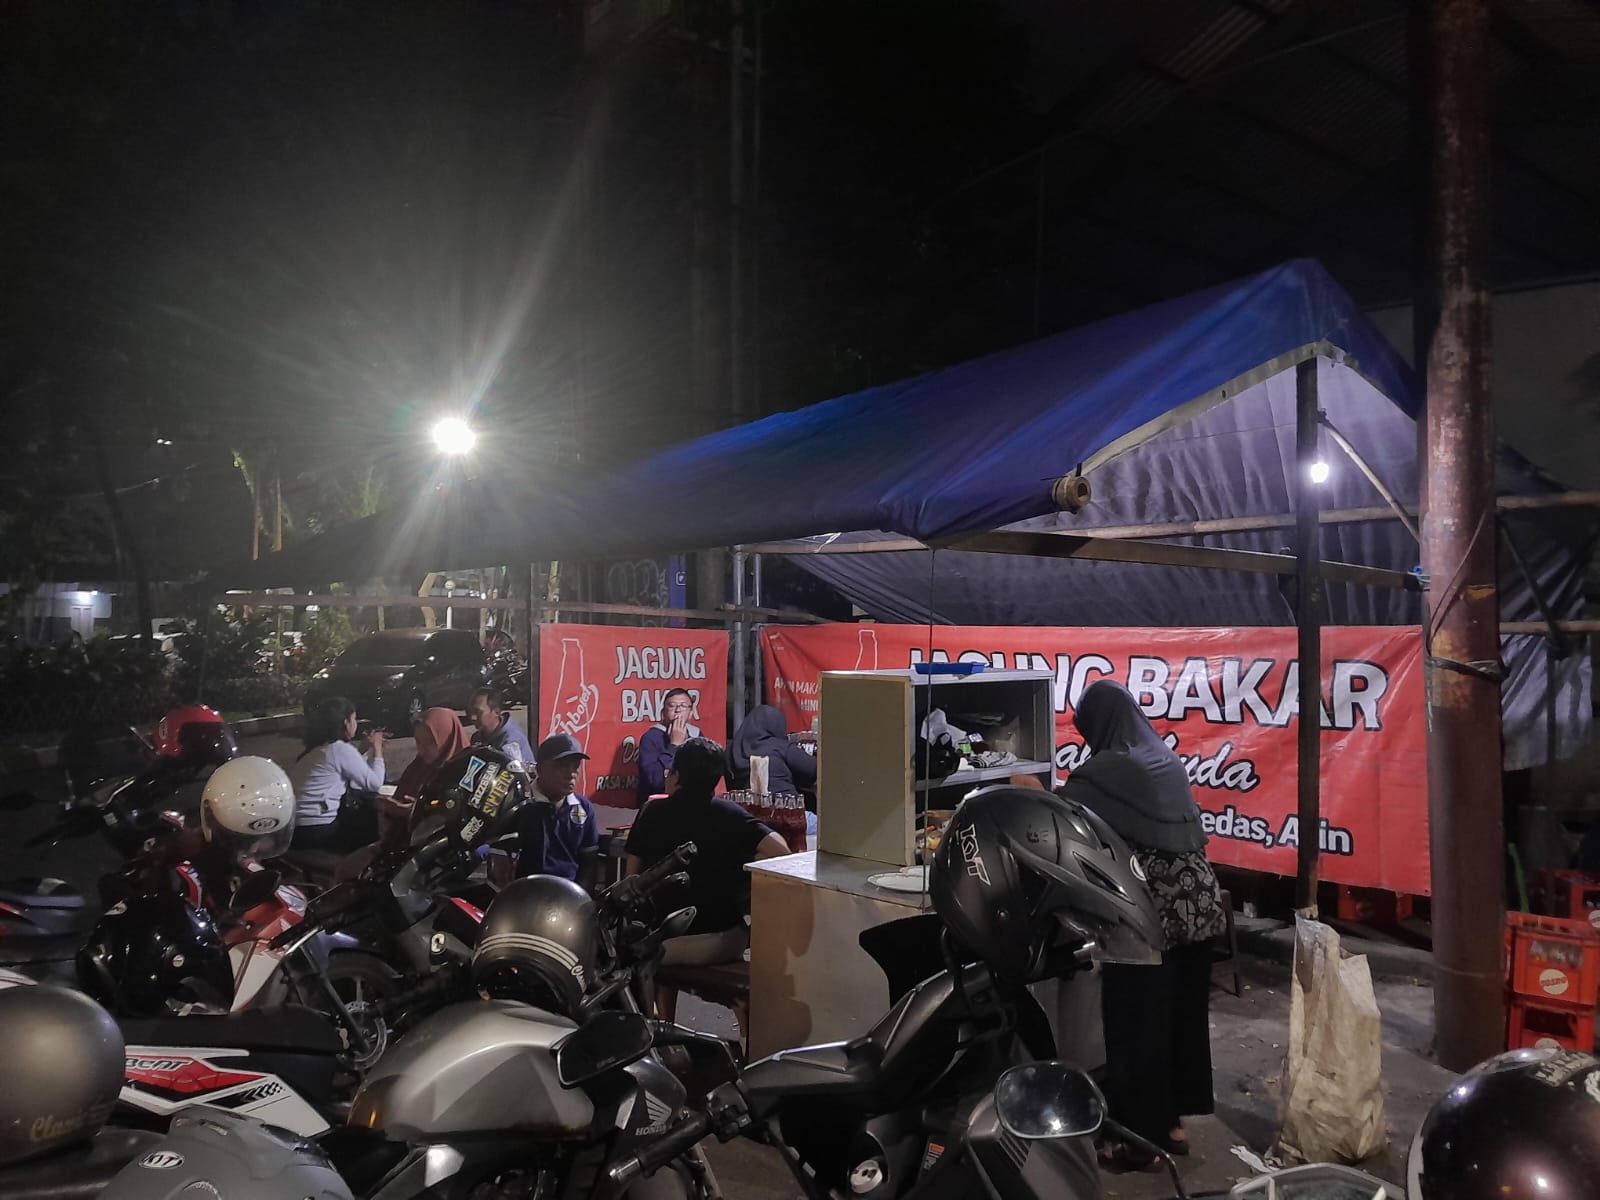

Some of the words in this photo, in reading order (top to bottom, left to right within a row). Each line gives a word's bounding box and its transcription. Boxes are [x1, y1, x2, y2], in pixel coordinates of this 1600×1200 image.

[615, 646, 706, 684] JAGUNG
[621, 689, 700, 723] BAKR
[1164, 731, 1261, 792] uda
[1200, 805, 1274, 848] edas,
[1277, 814, 1353, 855] Ain
